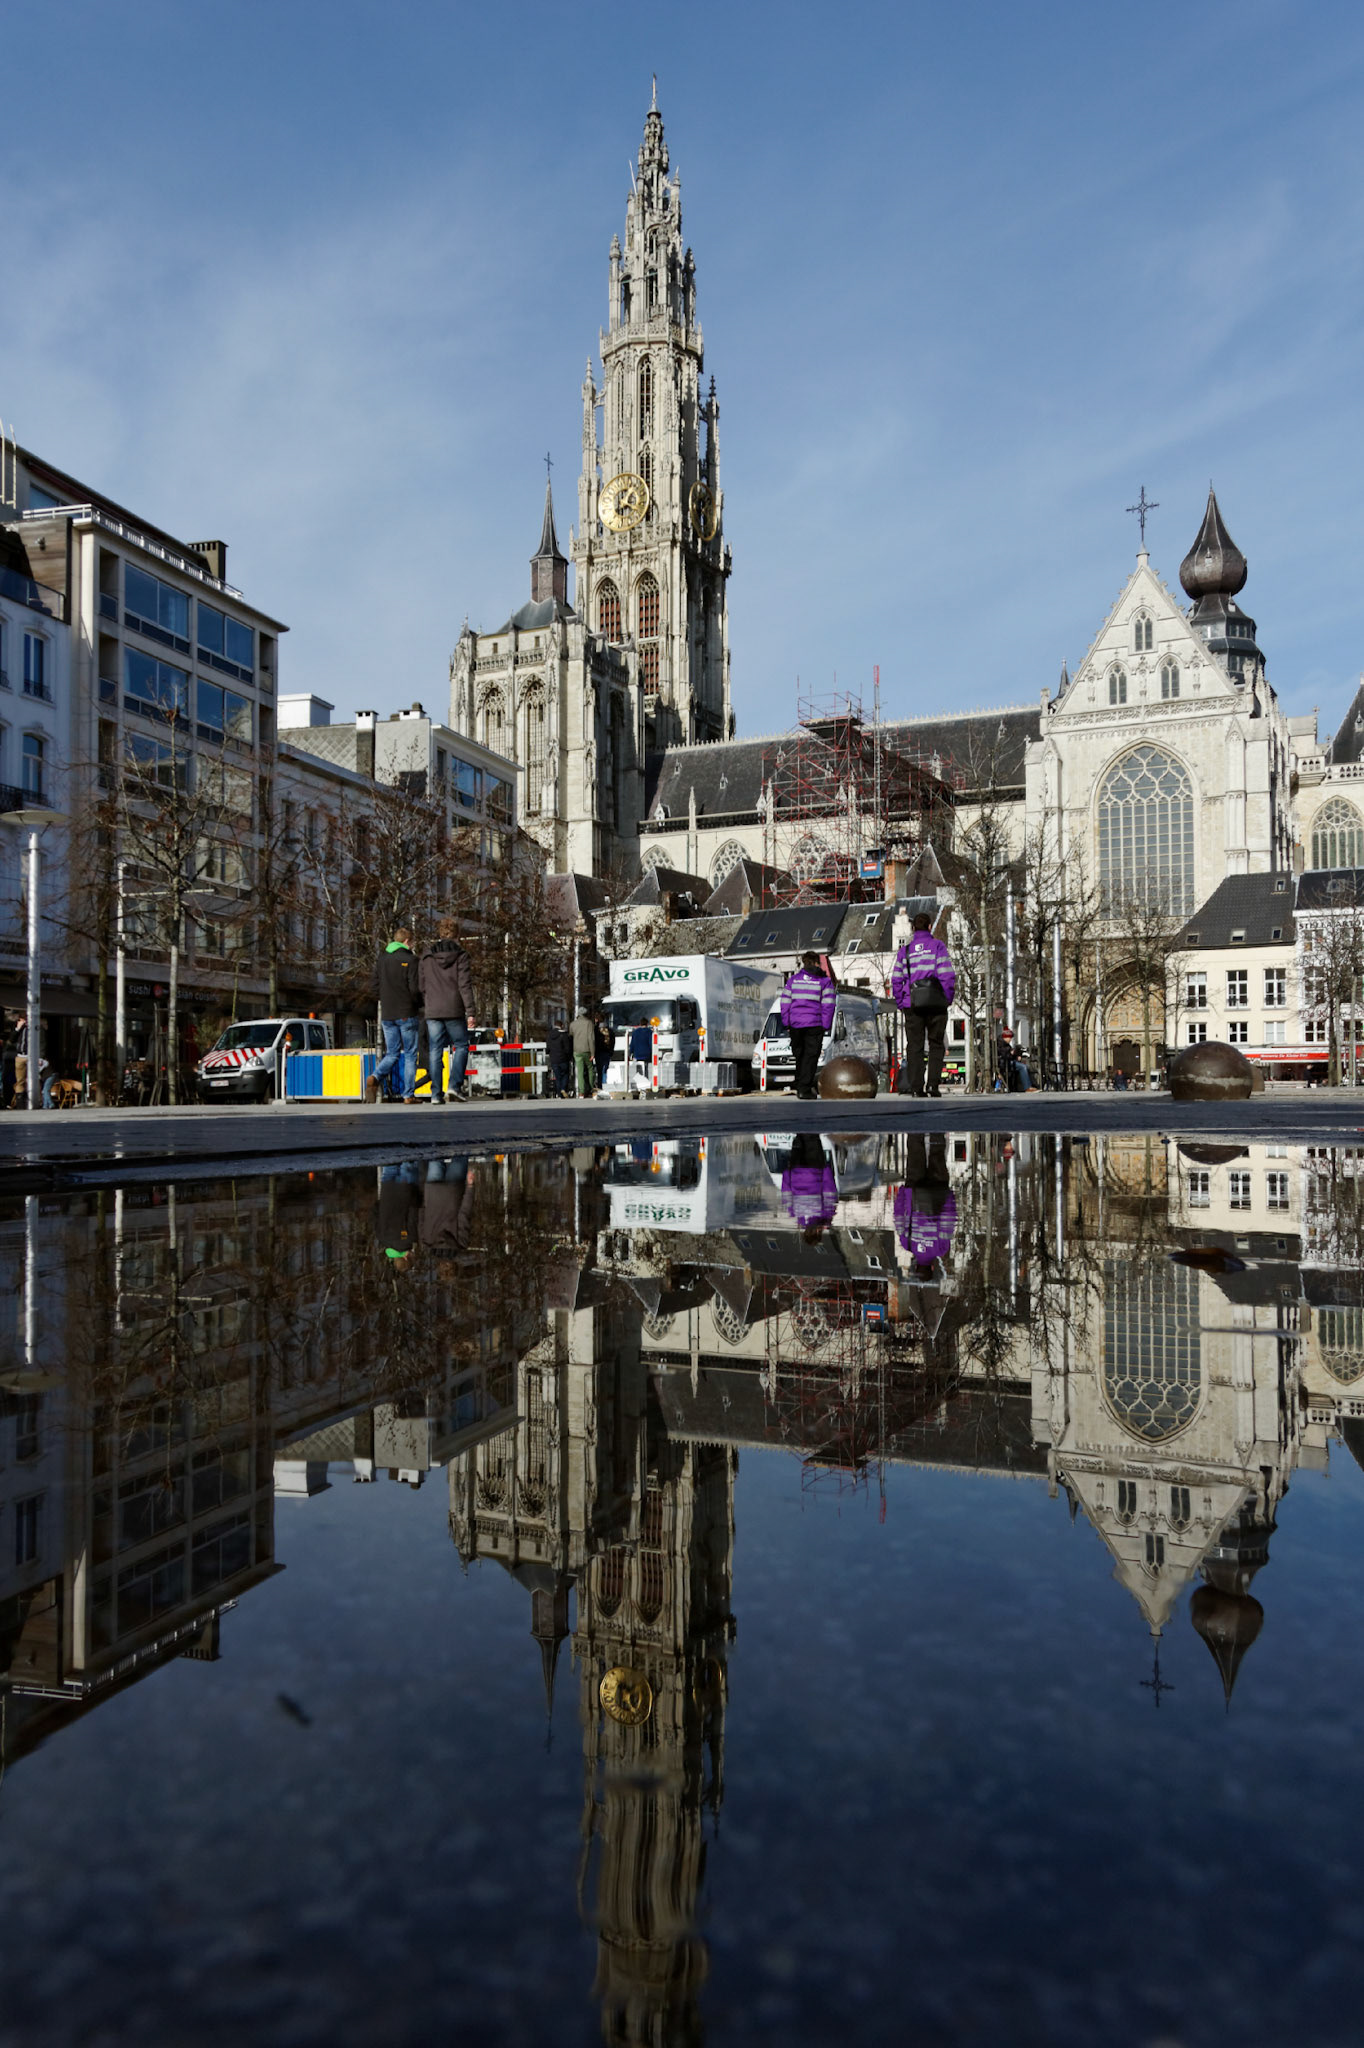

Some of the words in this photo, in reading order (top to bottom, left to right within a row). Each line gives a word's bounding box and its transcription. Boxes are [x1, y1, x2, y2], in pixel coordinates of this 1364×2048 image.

[624, 967, 690, 982] GRAVO
[128, 984, 151, 996] sushi
[733, 980, 761, 1000] GRAVO
